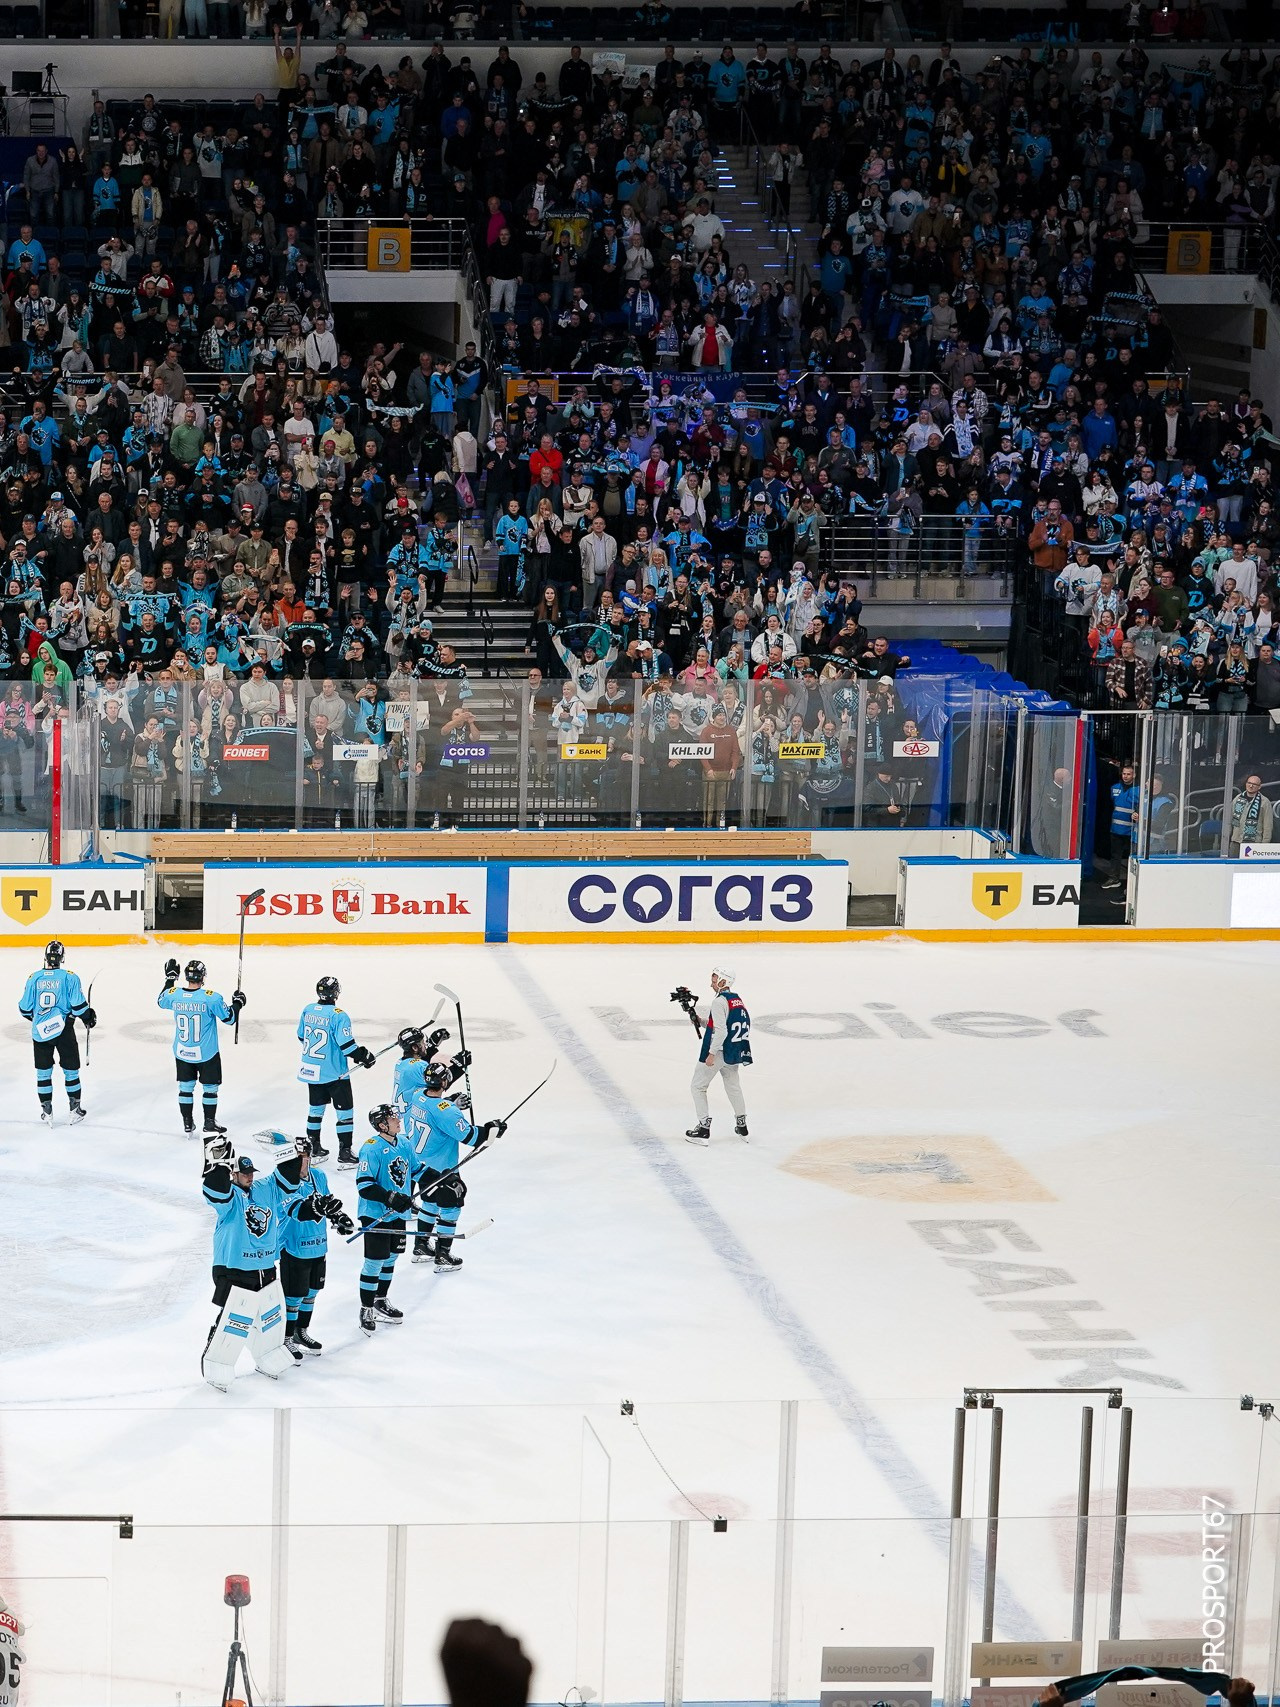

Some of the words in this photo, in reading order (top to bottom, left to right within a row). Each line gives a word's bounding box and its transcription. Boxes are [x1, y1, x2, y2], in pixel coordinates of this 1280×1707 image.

[378, 238, 401, 265] B
[1177, 239, 1201, 267] B
[224, 748, 268, 758] FONBET
[448, 746, 486, 757] согаз
[670, 746, 712, 756] KHL.RU
[781, 746, 801, 755] MAX
[800, 748, 822, 756] LINE
[15, 889, 38, 910] Т
[235, 893, 324, 916] BSB
[370, 892, 471, 915] Bank
[567, 874, 813, 923] согаз
[985, 884, 1009, 906] Т
[36, 980, 60, 990] LIPSKY
[38, 991, 57, 1016] 9
[176, 1013, 202, 1043] 91
[730, 1021, 750, 1043] 22
[303, 1025, 329, 1061] 62
[228, 1321, 249, 1330] TRUE
